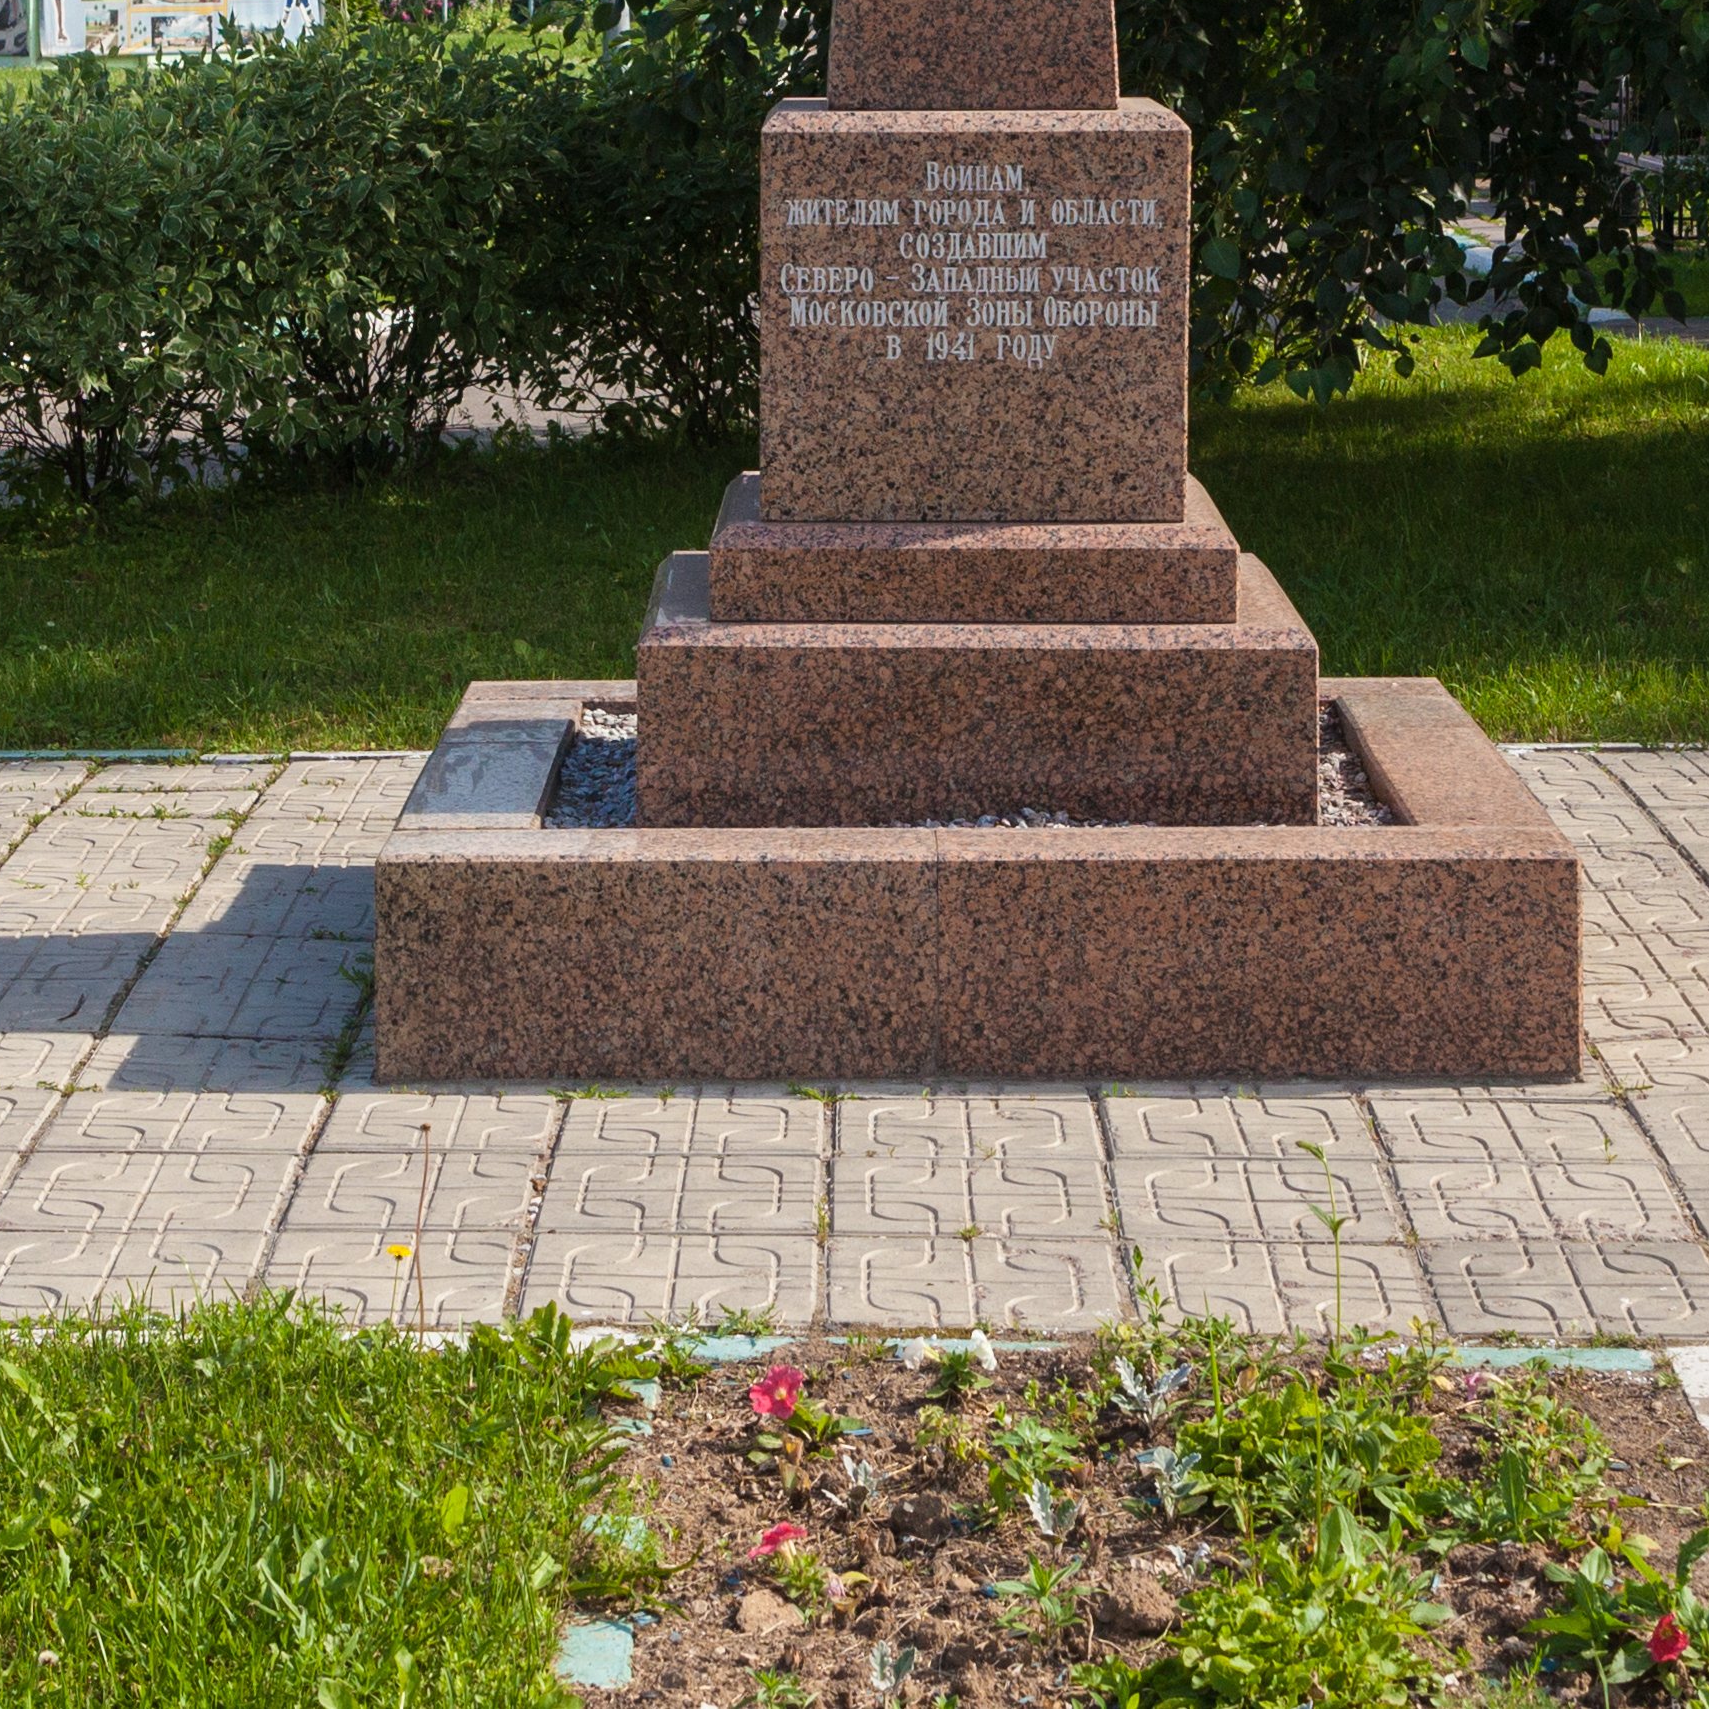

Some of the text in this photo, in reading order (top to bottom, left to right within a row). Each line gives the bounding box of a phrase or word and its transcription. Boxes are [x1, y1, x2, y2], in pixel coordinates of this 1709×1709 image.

[784, 198, 1164, 230] ЖИТЕЛЯМ ГОРОДА И ОБЛАСТИ,
[899, 232, 1048, 264] СОЗДАВШИМ
[780, 262, 874, 294] СЕВЕРО
[1051, 266, 1161, 293] УЧАСТОК
[790, 295, 1158, 328] МОСКОВСКОЙ ЗОНЫ ОБОРОНЫ
[887, 331, 1059, 369] В 1941 ГОДУ
